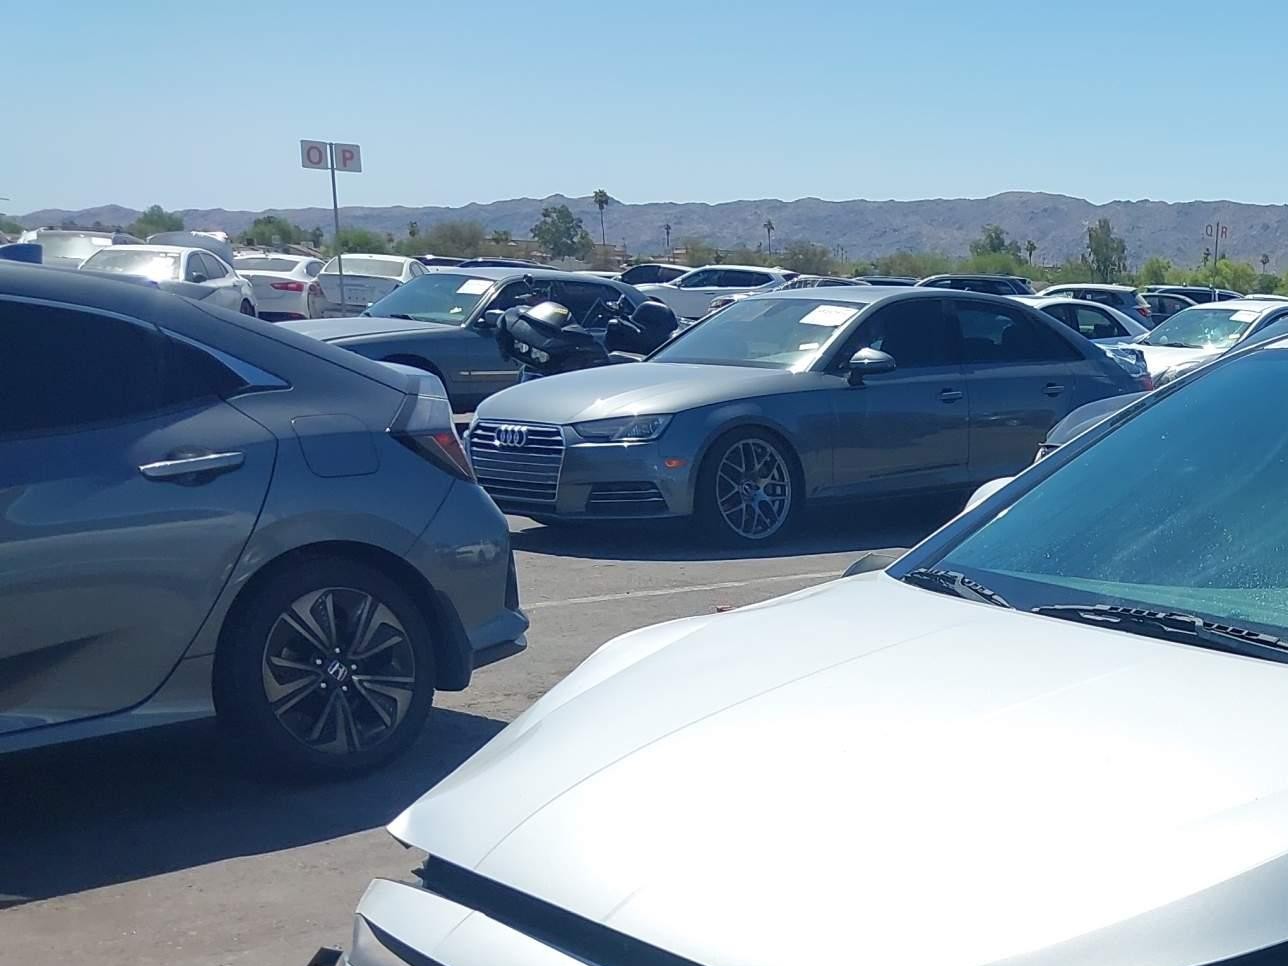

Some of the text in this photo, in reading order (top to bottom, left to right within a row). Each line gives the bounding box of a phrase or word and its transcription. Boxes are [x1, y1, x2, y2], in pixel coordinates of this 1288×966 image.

[306, 146, 323, 166] O
[342, 149, 354, 168] P
[1206, 224, 1213, 237] Q
[1221, 226, 1228, 239] R
